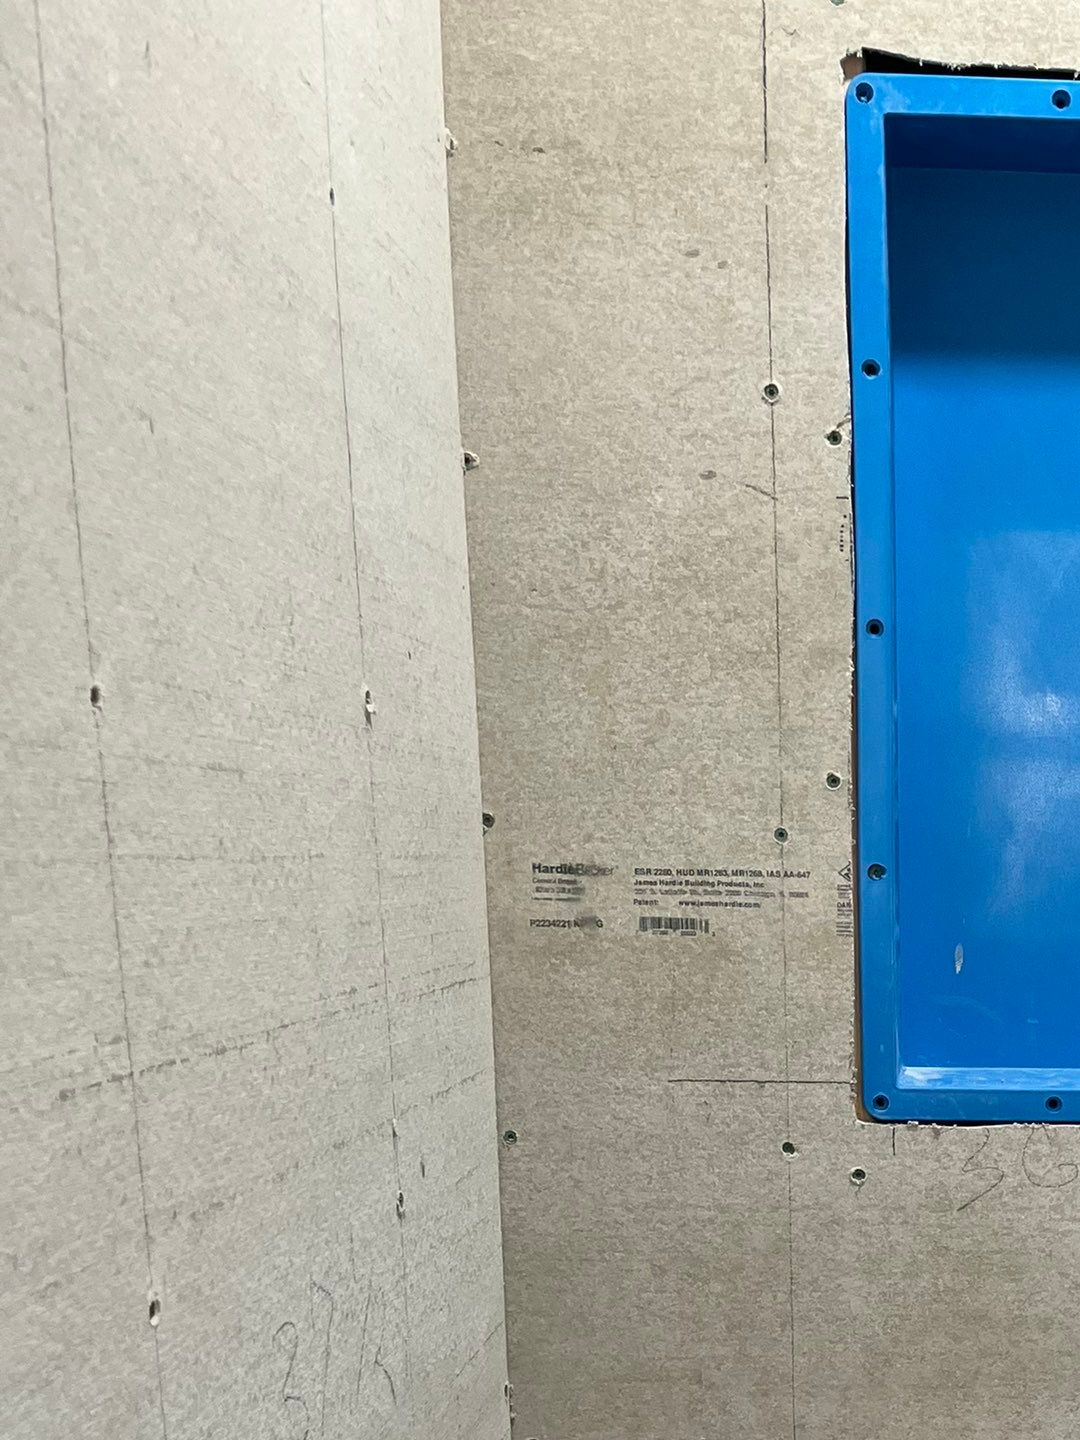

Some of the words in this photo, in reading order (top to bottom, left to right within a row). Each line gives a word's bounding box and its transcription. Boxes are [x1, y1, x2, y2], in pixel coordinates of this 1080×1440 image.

[766, 870, 781, 878] IAS
[684, 880, 716, 888] Building
[678, 899, 761, 908] www.jameshardie.com
